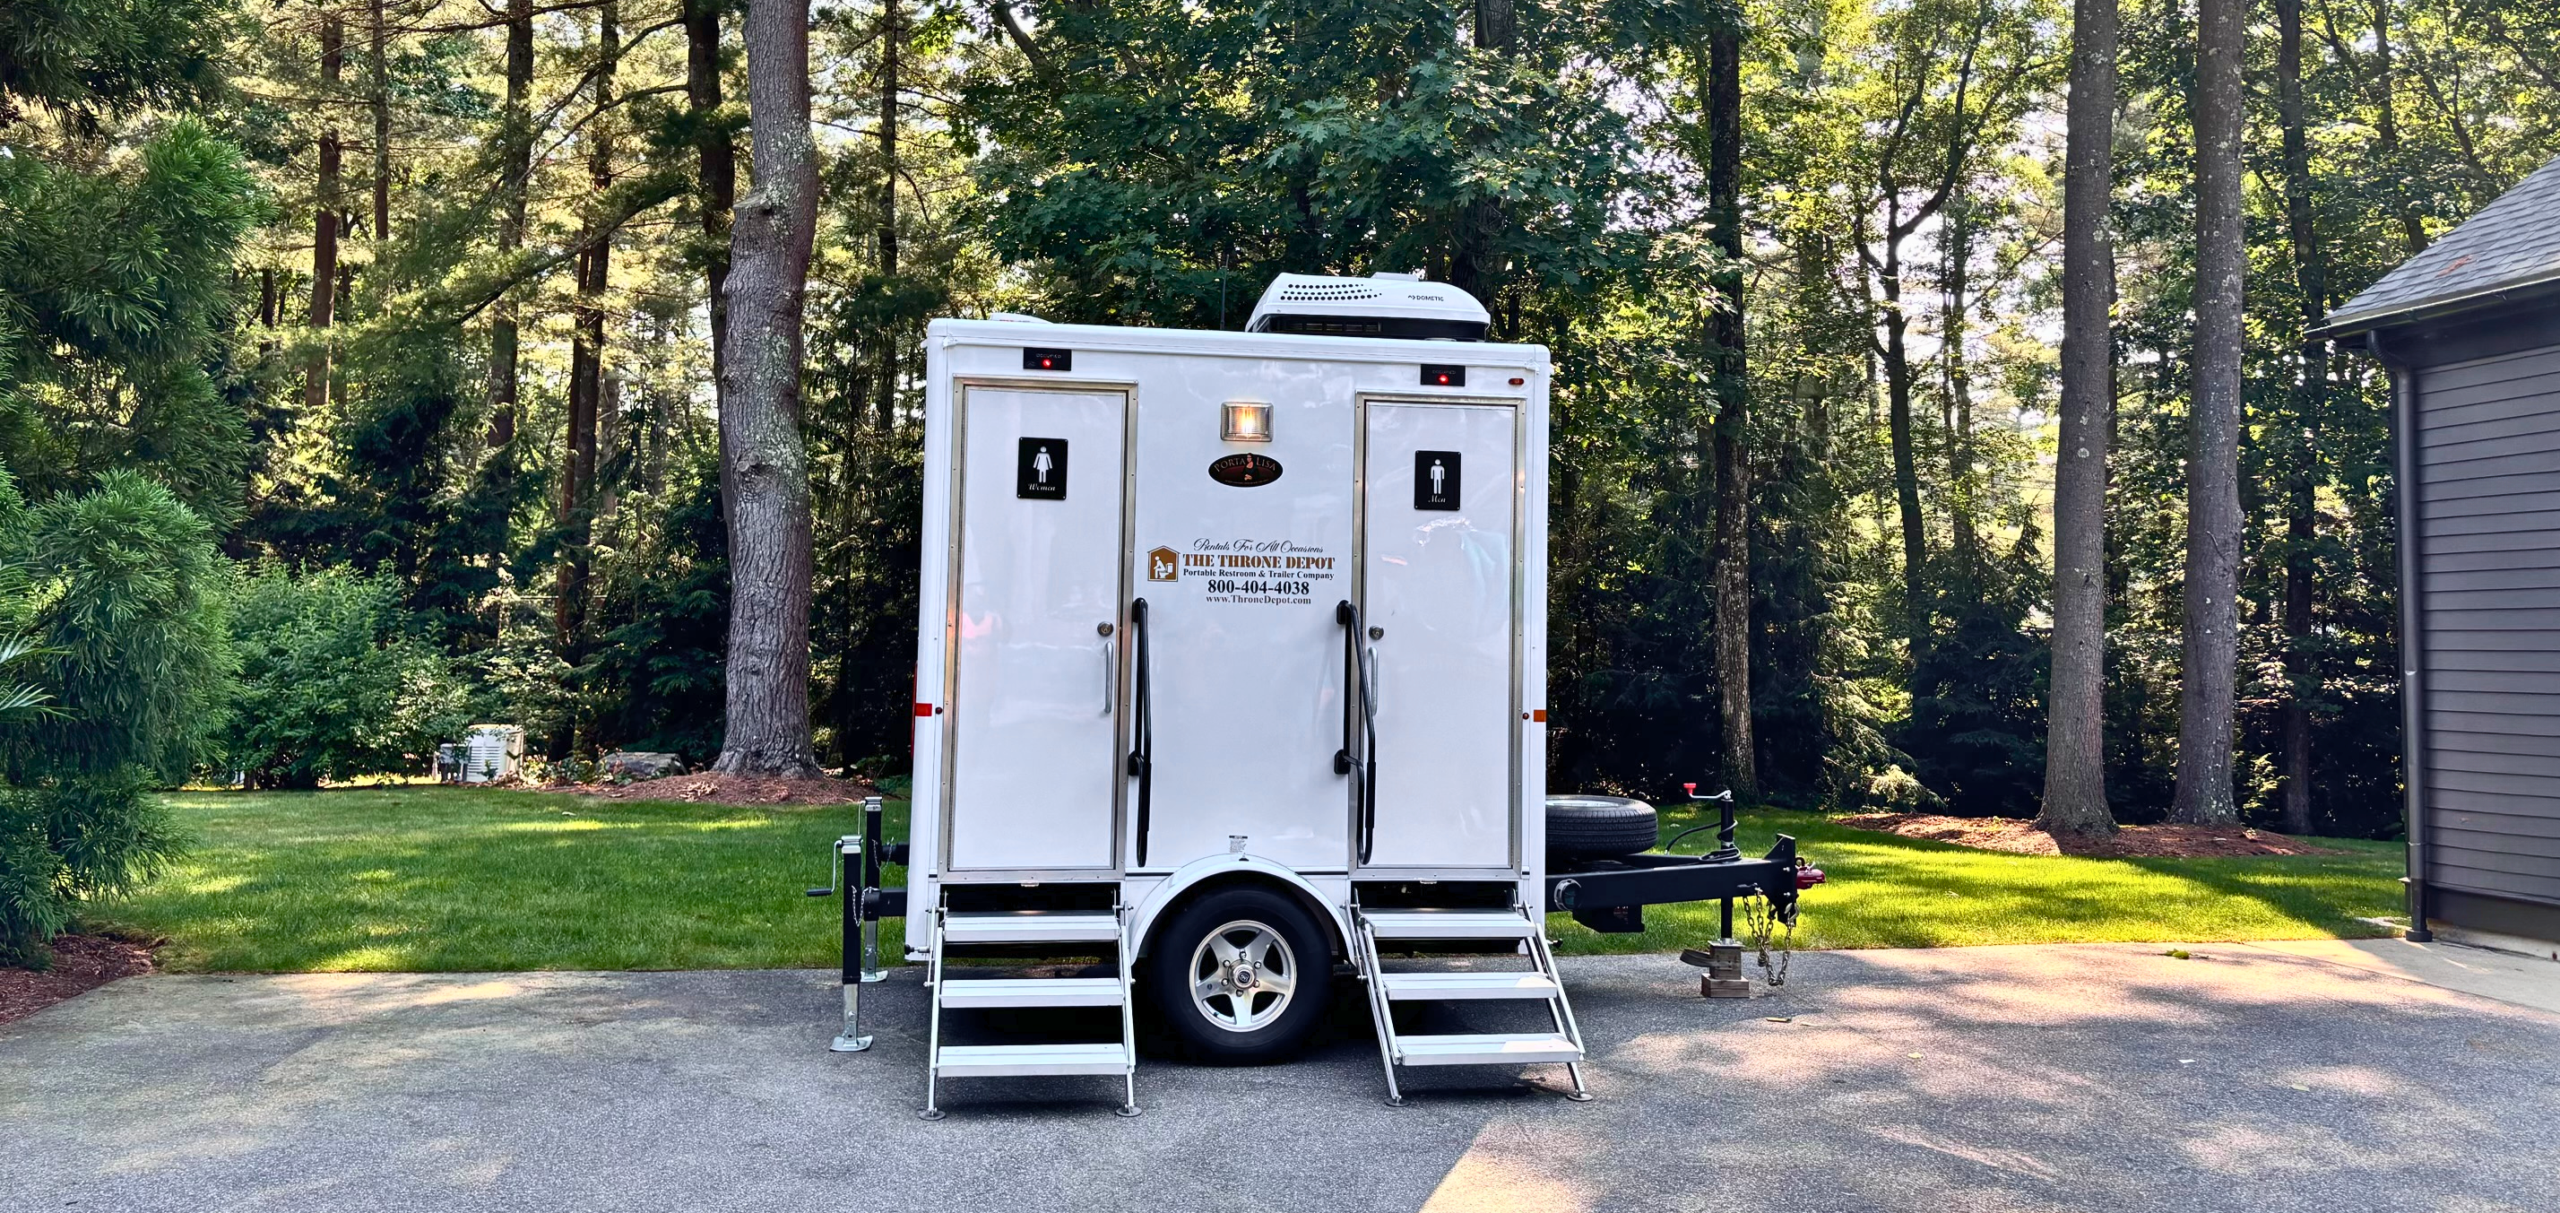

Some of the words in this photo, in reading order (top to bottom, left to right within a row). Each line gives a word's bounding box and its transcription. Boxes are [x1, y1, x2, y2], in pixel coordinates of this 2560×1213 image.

[1214, 457, 1246, 472] PORTA
[1256, 456, 1276, 471] LISA
[1193, 538, 1230, 552] Rentals
[1233, 539, 1254, 553] For
[1255, 540, 1281, 553] All
[1280, 540, 1324, 554] Occasions
[1182, 553, 1215, 567] THE
[1217, 554, 1282, 569] THRONE
[1285, 556, 1336, 570] DEPOT
[1183, 568, 1217, 577] Portable
[1219, 569, 1257, 578] Restroom
[1258, 570, 1266, 578] &
[1268, 570, 1295, 579] Trailer
[1296, 571, 1335, 581] Company
[1207, 579, 1310, 595] 800-404-4038
[1205, 594, 1312, 606] www.ThroneDepot.com
